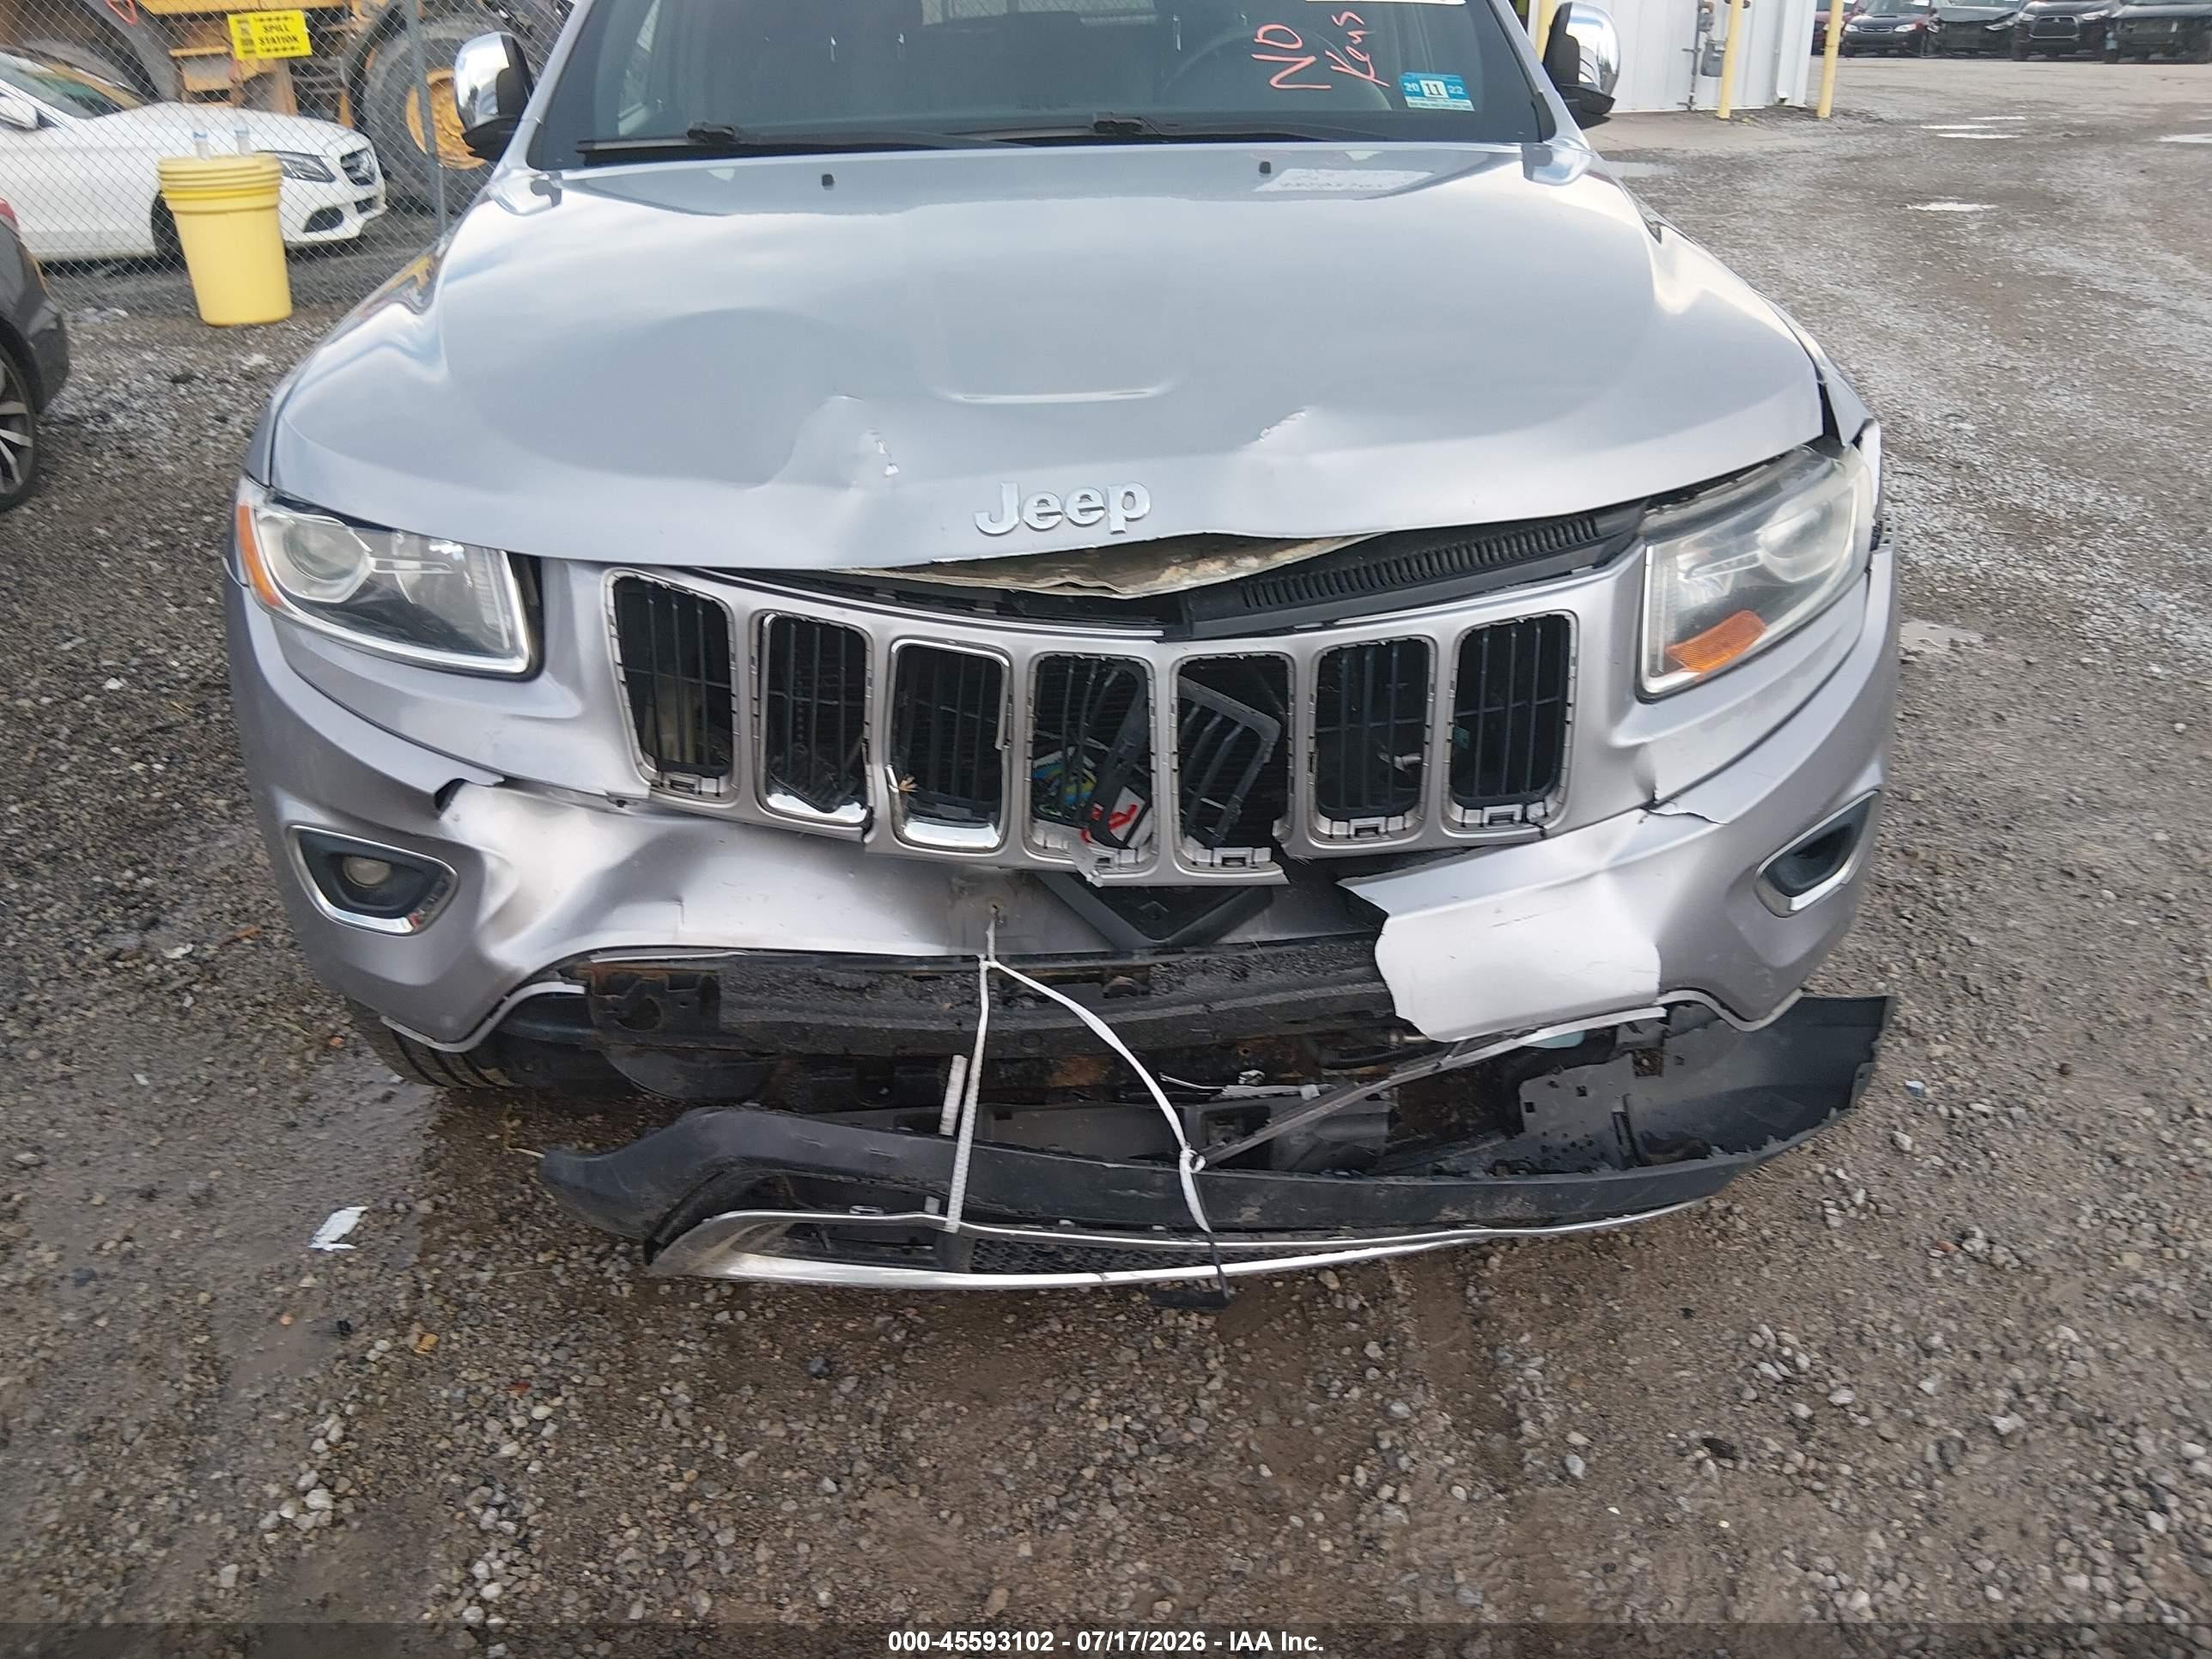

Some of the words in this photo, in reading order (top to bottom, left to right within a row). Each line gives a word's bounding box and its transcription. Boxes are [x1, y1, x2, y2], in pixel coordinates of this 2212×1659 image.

[262, 23, 289, 34] SPILL
[258, 34, 299, 46] STATION
[1250, 23, 1332, 89] NO
[1403, 82, 1420, 93] 20
[1424, 82, 1444, 96] 11
[974, 481, 1152, 537] Jeep
